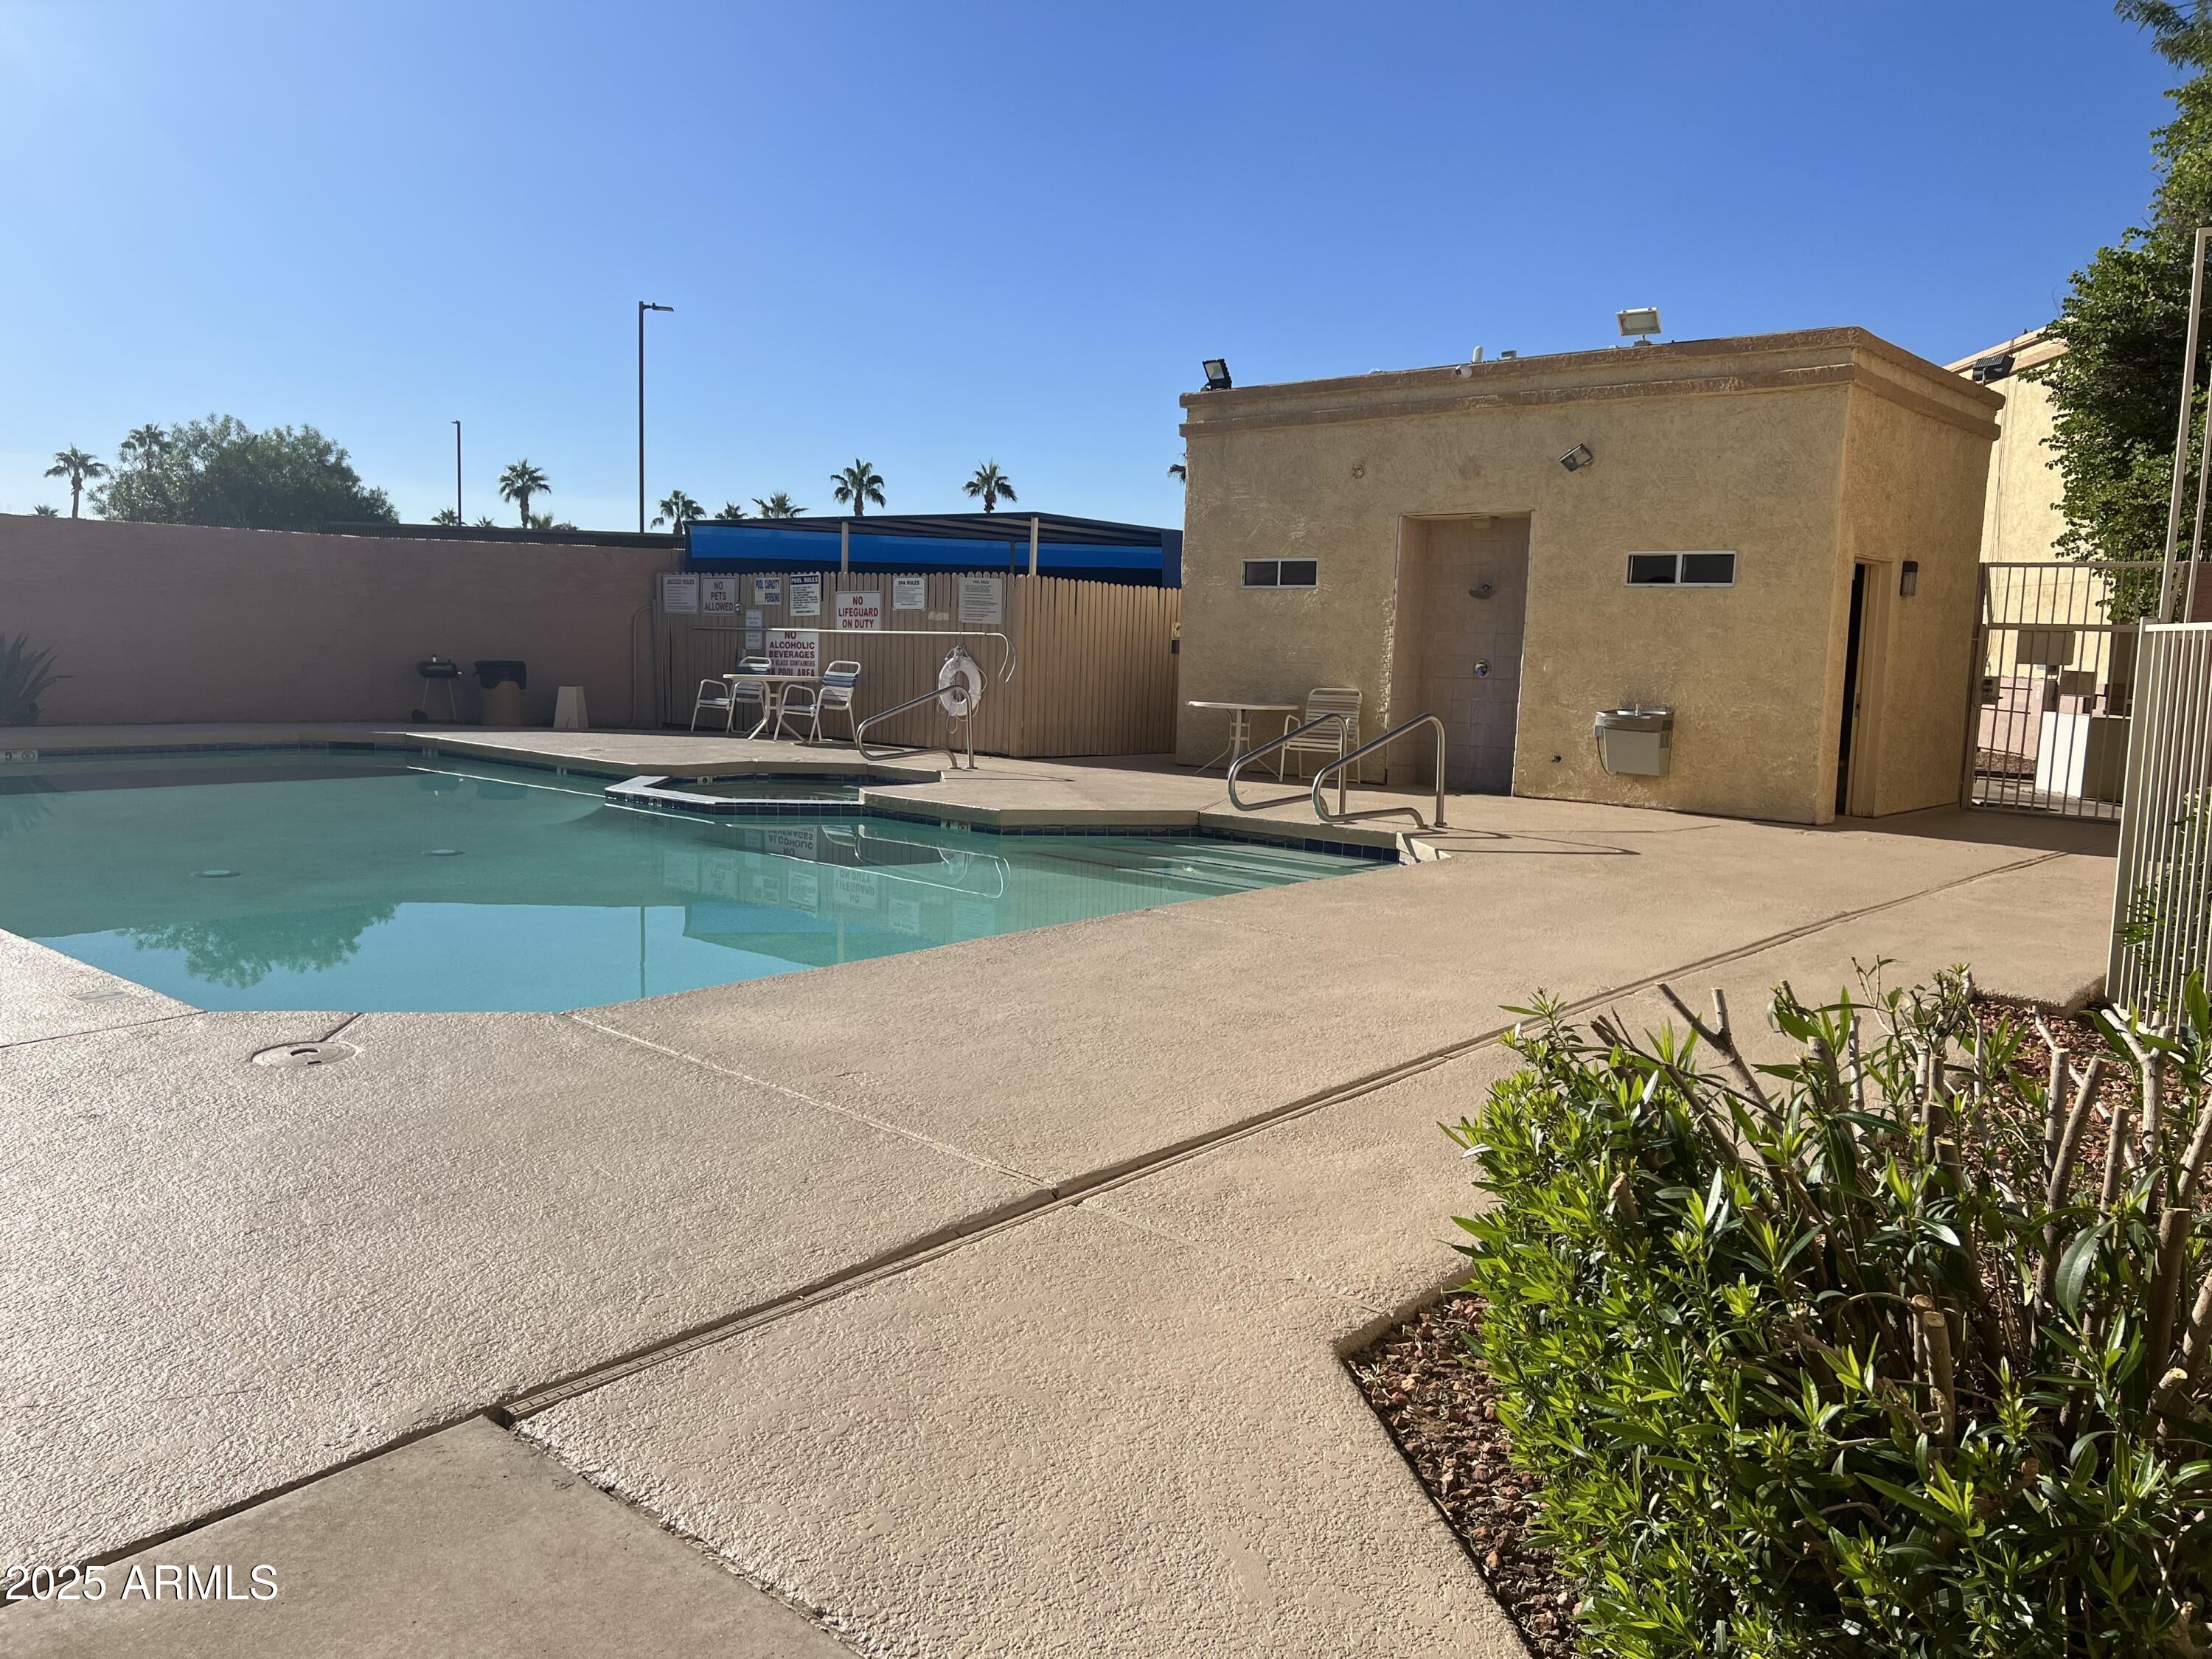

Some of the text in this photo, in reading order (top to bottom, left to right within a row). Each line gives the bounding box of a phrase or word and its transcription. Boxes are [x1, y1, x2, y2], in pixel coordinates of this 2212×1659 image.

[714, 581, 723, 590] NO
[756, 579, 780, 590] POOL CAPACITY
[710, 592, 726, 600] PETS
[765, 592, 780, 602] PERSONS
[852, 596, 863, 605] NO
[704, 602, 733, 611] ALLOWED
[838, 608, 878, 617] LIFEGUARD
[842, 619, 874, 628] ON DUTY
[785, 631, 797, 639] NO
[769, 641, 815, 650] ALCOHOLIC
[768, 650, 815, 658] BEVERAGES
[779, 668, 793, 676] POOL
[797, 669, 815, 677] AREA
